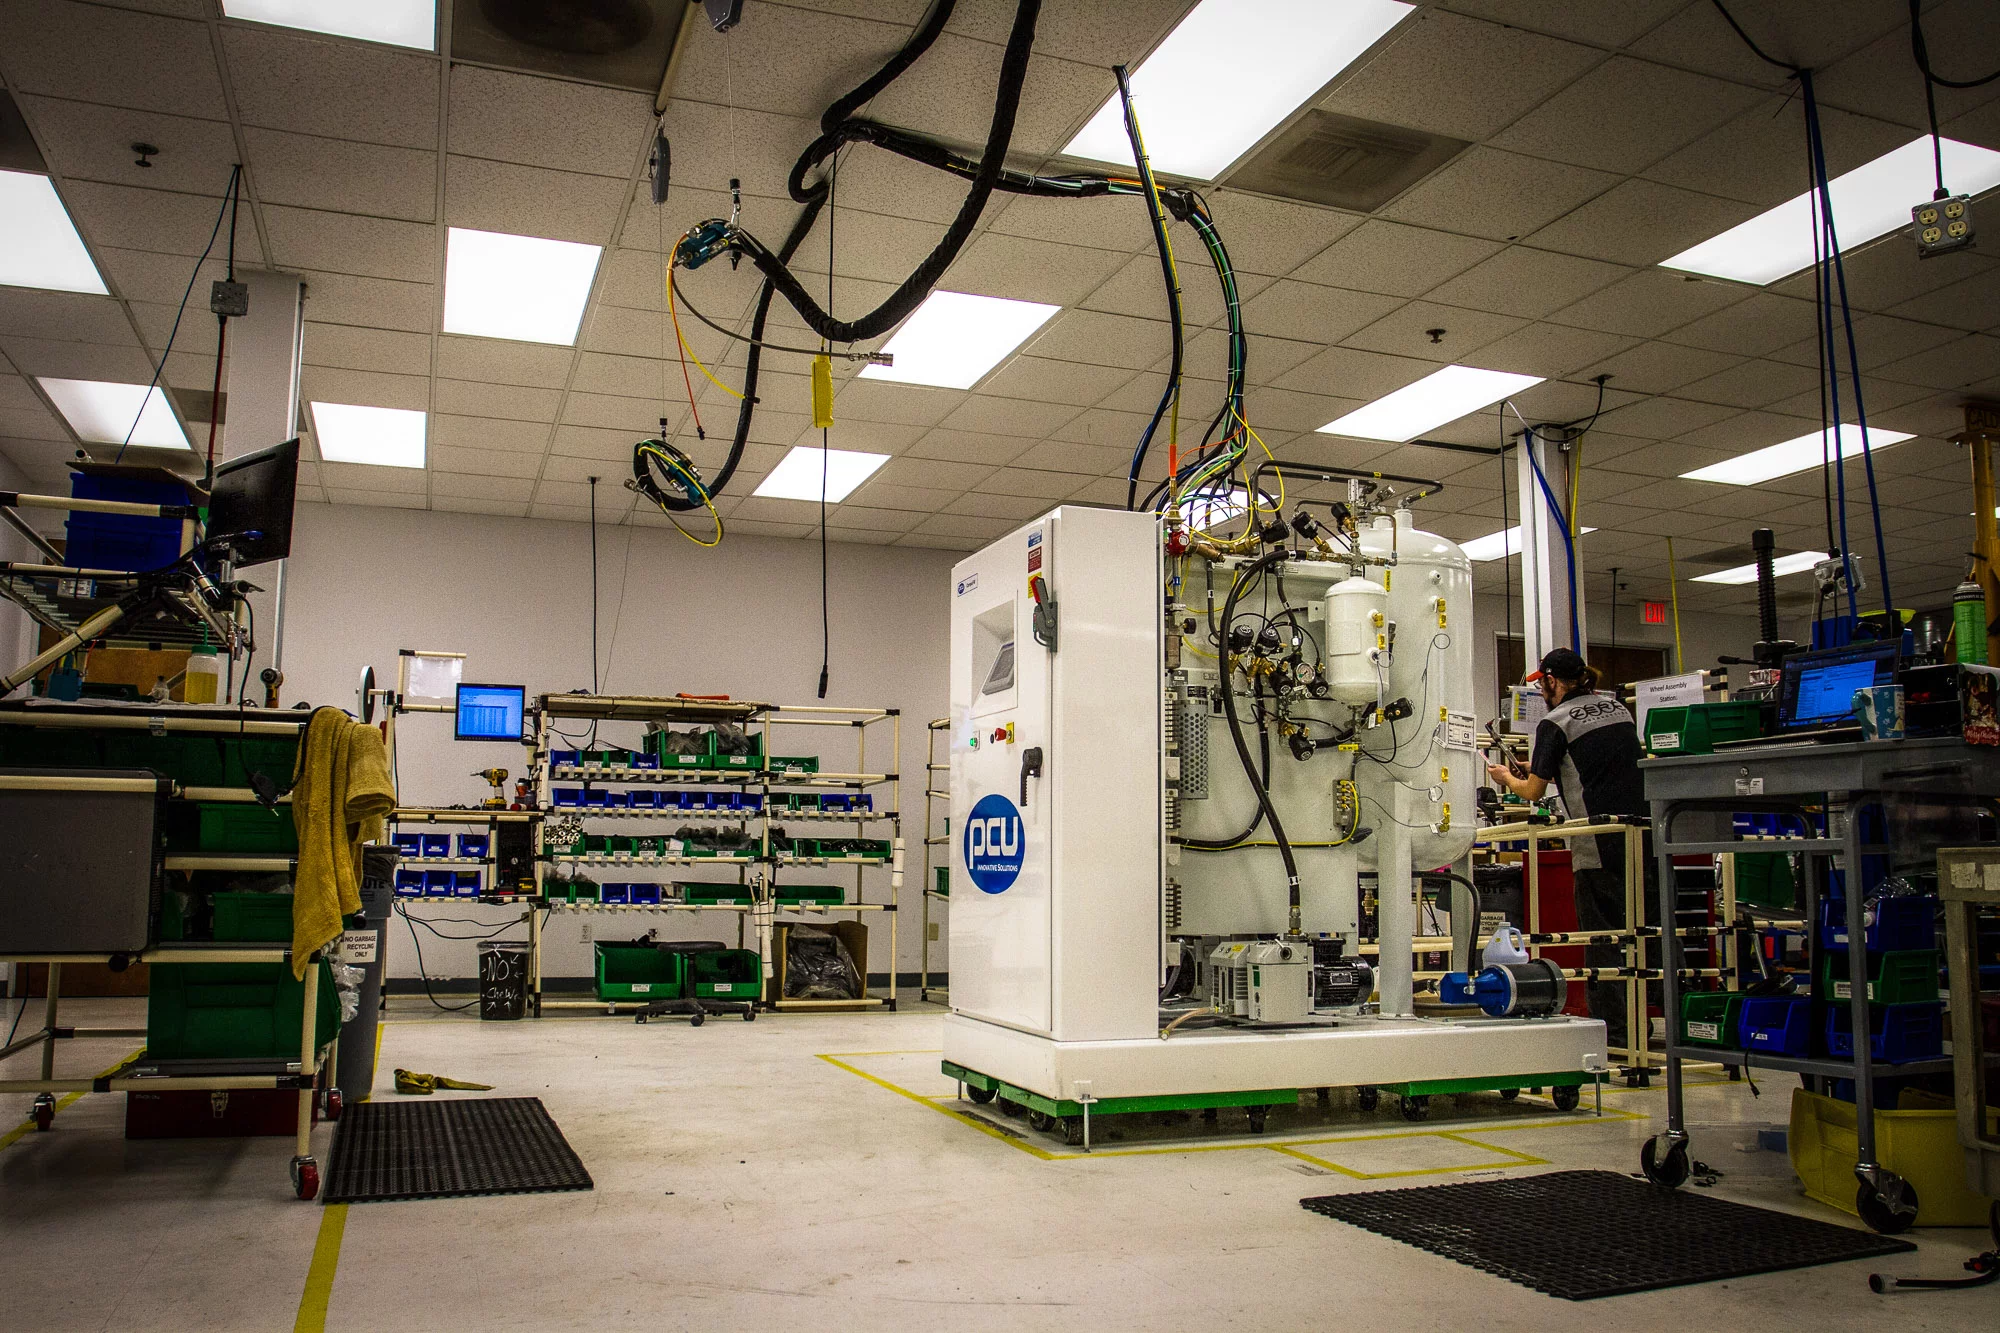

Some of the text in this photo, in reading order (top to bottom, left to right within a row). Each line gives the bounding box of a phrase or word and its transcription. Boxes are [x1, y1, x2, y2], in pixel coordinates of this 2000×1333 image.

[1645, 602, 1665, 623] EXIT
[1650, 682, 1687, 693] Wheel Assembly
[354, 935, 376, 943] GARBAGE
[486, 956, 510, 982] NO
